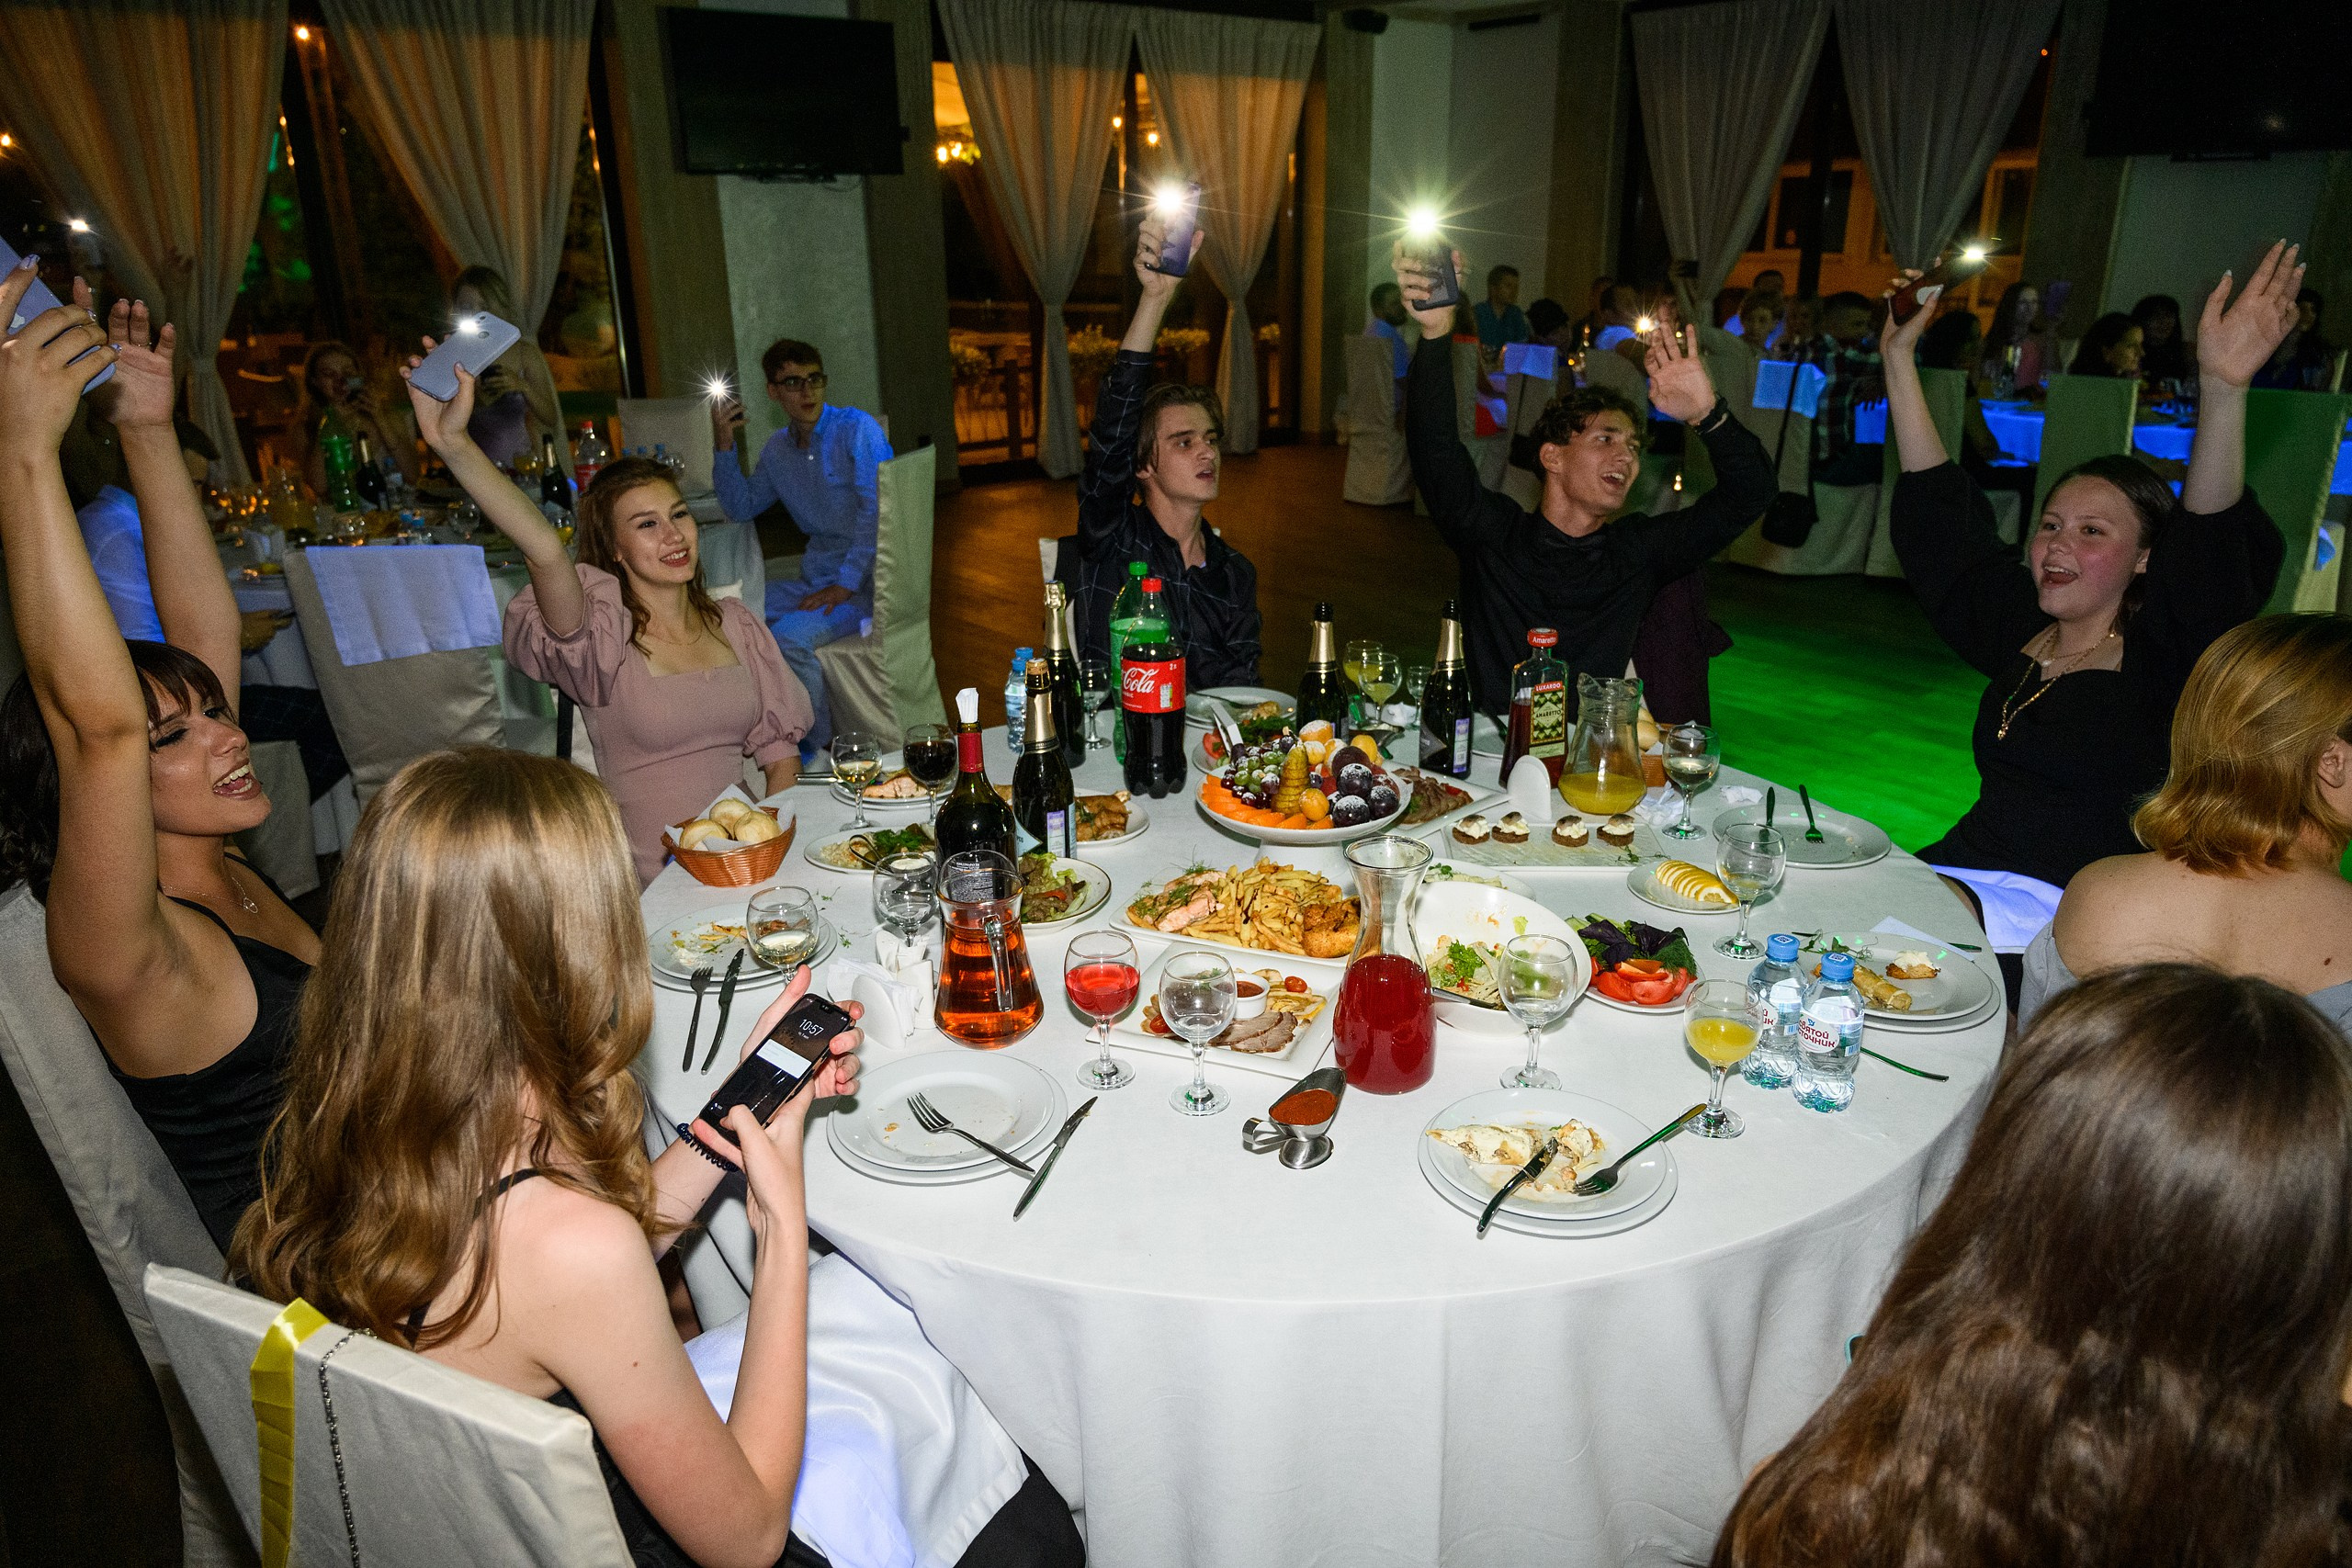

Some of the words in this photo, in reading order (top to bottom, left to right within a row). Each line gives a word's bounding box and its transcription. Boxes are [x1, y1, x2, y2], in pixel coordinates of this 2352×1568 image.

[1532, 636, 1556, 644] Amaretto
[1535, 682, 1561, 692] LUXARDO
[1535, 709, 1562, 718] AMARETTO
[799, 1019, 824, 1036] 10:57
[1797, 1027, 1836, 1048] СТОЧНИК
